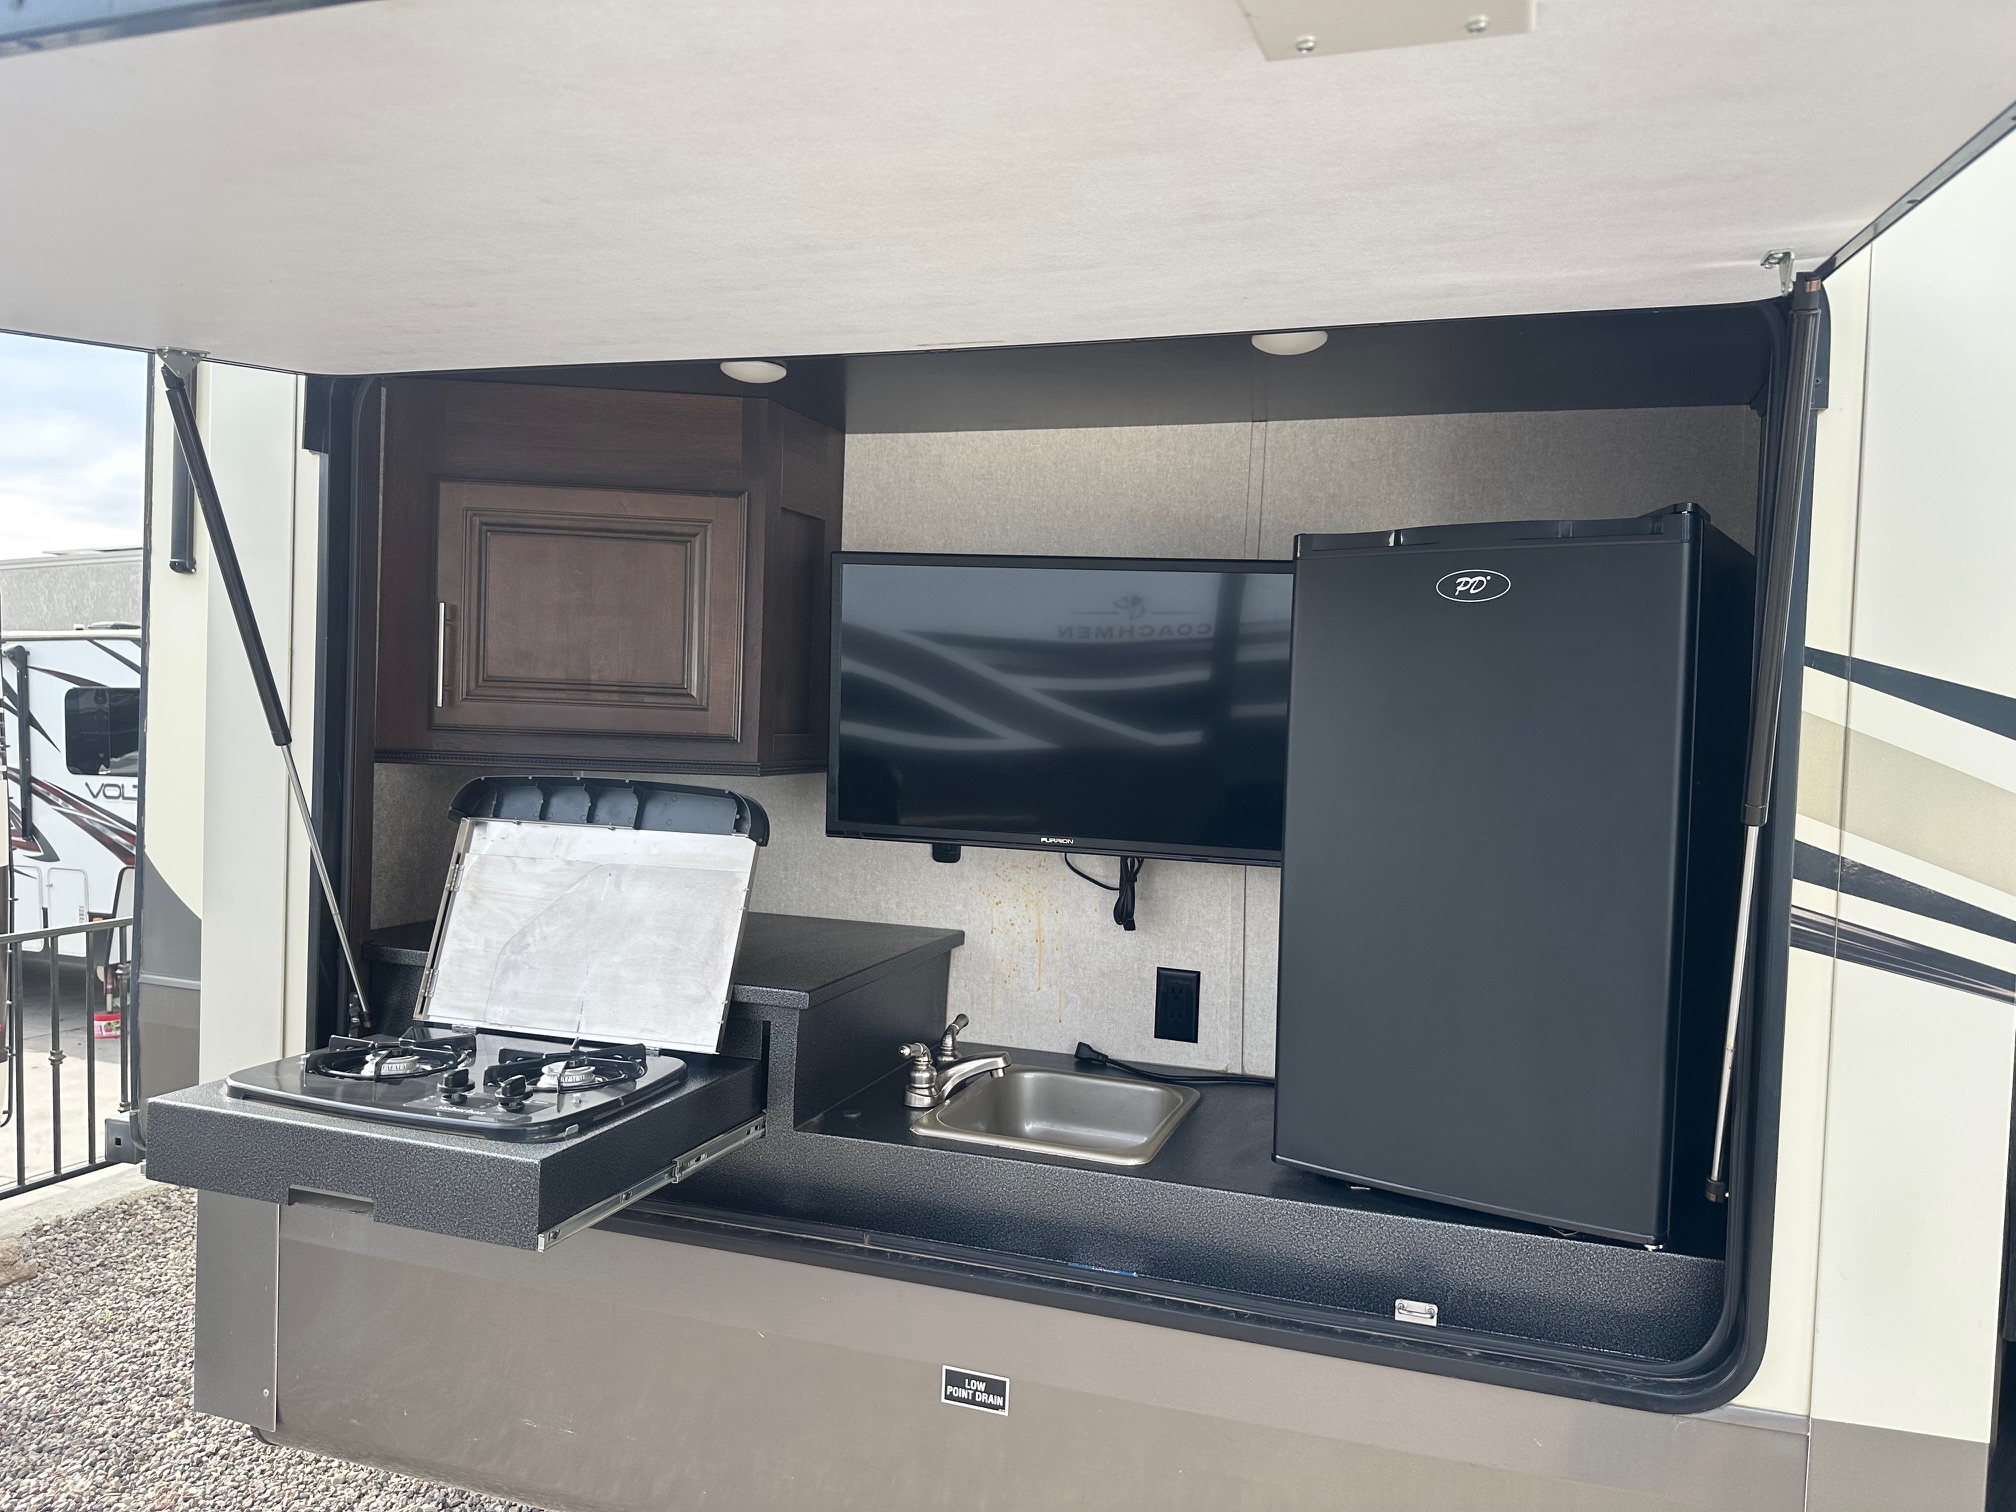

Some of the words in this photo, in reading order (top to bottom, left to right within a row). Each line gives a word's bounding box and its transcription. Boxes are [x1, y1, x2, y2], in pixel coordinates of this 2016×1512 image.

[965, 1378, 986, 1392] LOW
[946, 1385, 974, 1400] POINT
[975, 1391, 1004, 1406] DRAIN
